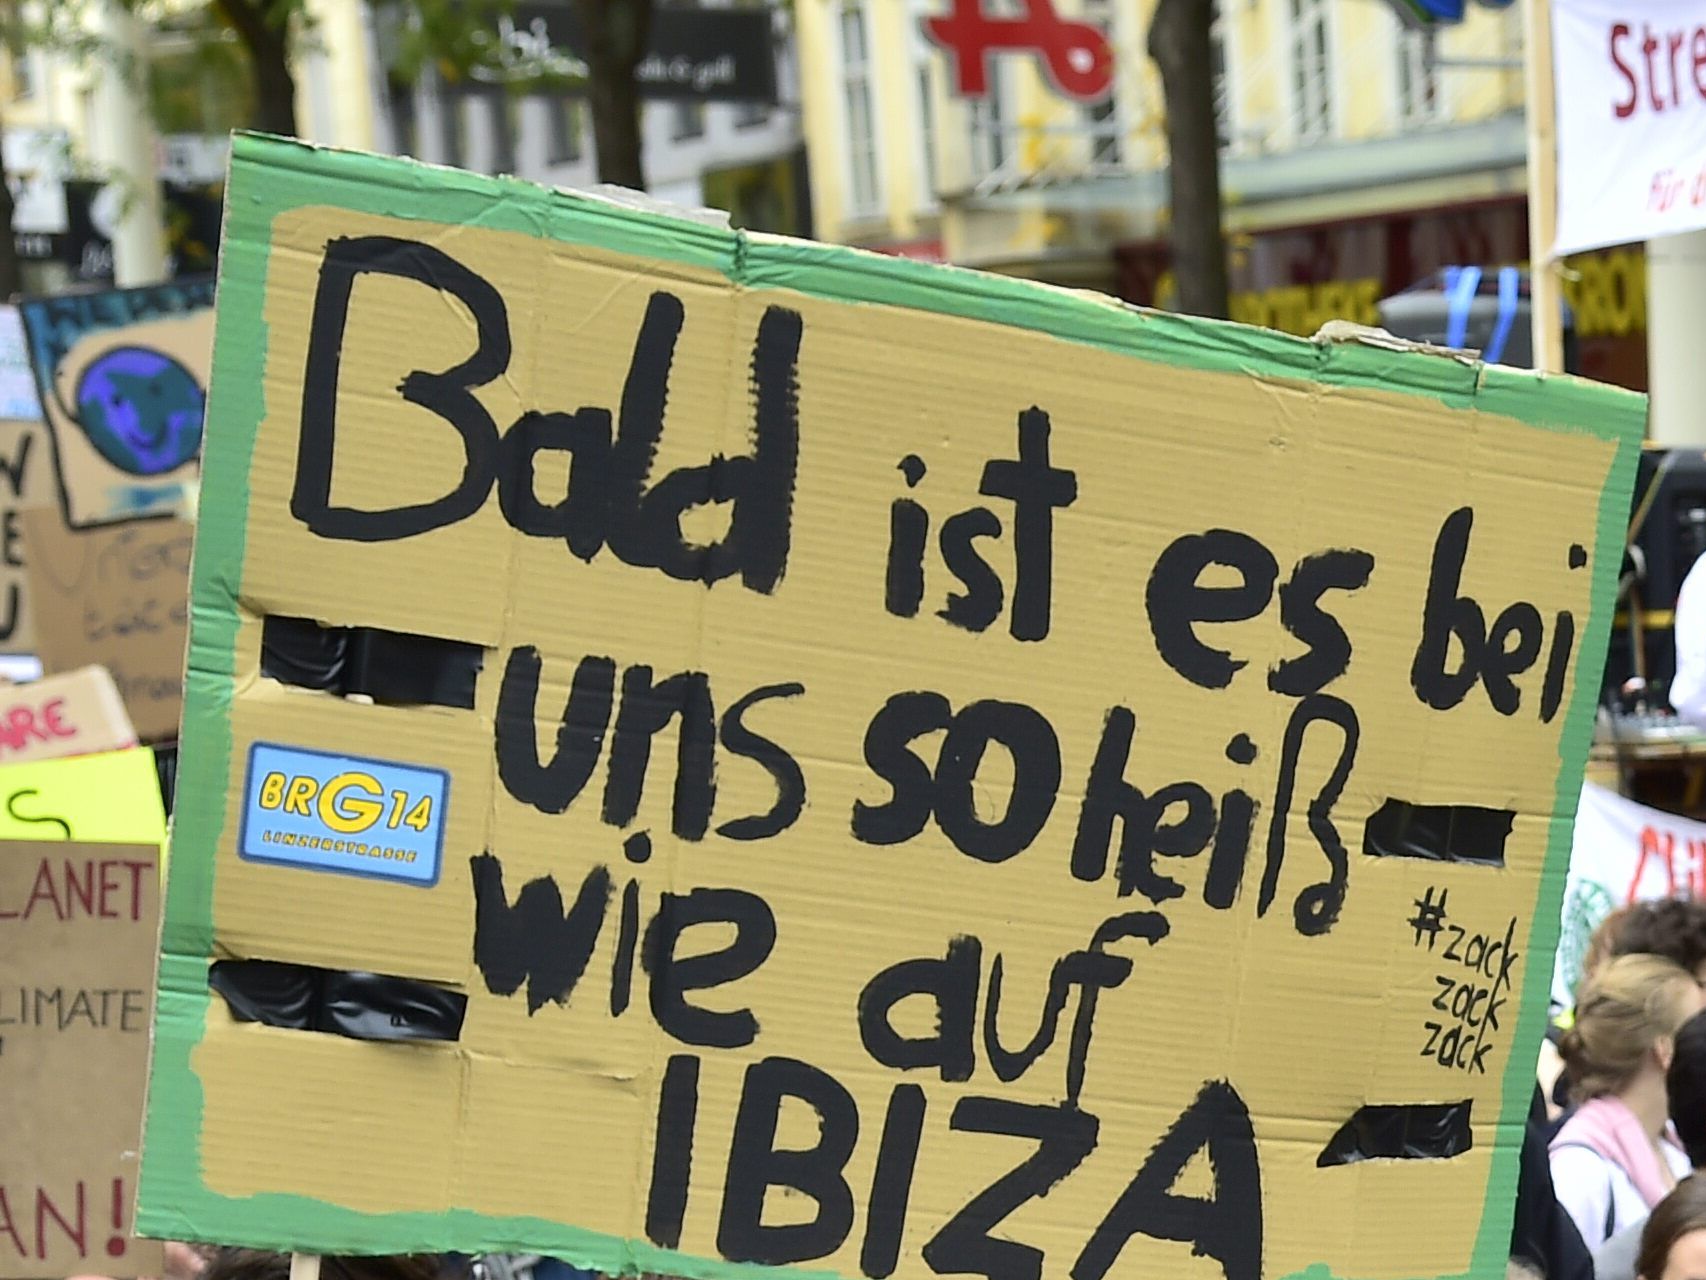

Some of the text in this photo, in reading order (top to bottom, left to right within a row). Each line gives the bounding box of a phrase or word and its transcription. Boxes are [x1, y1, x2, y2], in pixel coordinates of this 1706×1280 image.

[290, 236, 803, 595] Bald
[886, 406, 1077, 641] ist
[1147, 529, 1374, 697] es
[1411, 507, 1586, 722] bei
[494, 644, 806, 842] uns
[852, 690, 1061, 863] so
[1071, 693, 1359, 936] heiß
[262, 829, 418, 864] LINZERSTRASSE
[470, 829, 1170, 1108] wie auf
[1407, 886, 1518, 991] #zack
[1420, 1021, 1493, 1075] zack
[1432, 975, 1506, 1032] zack
